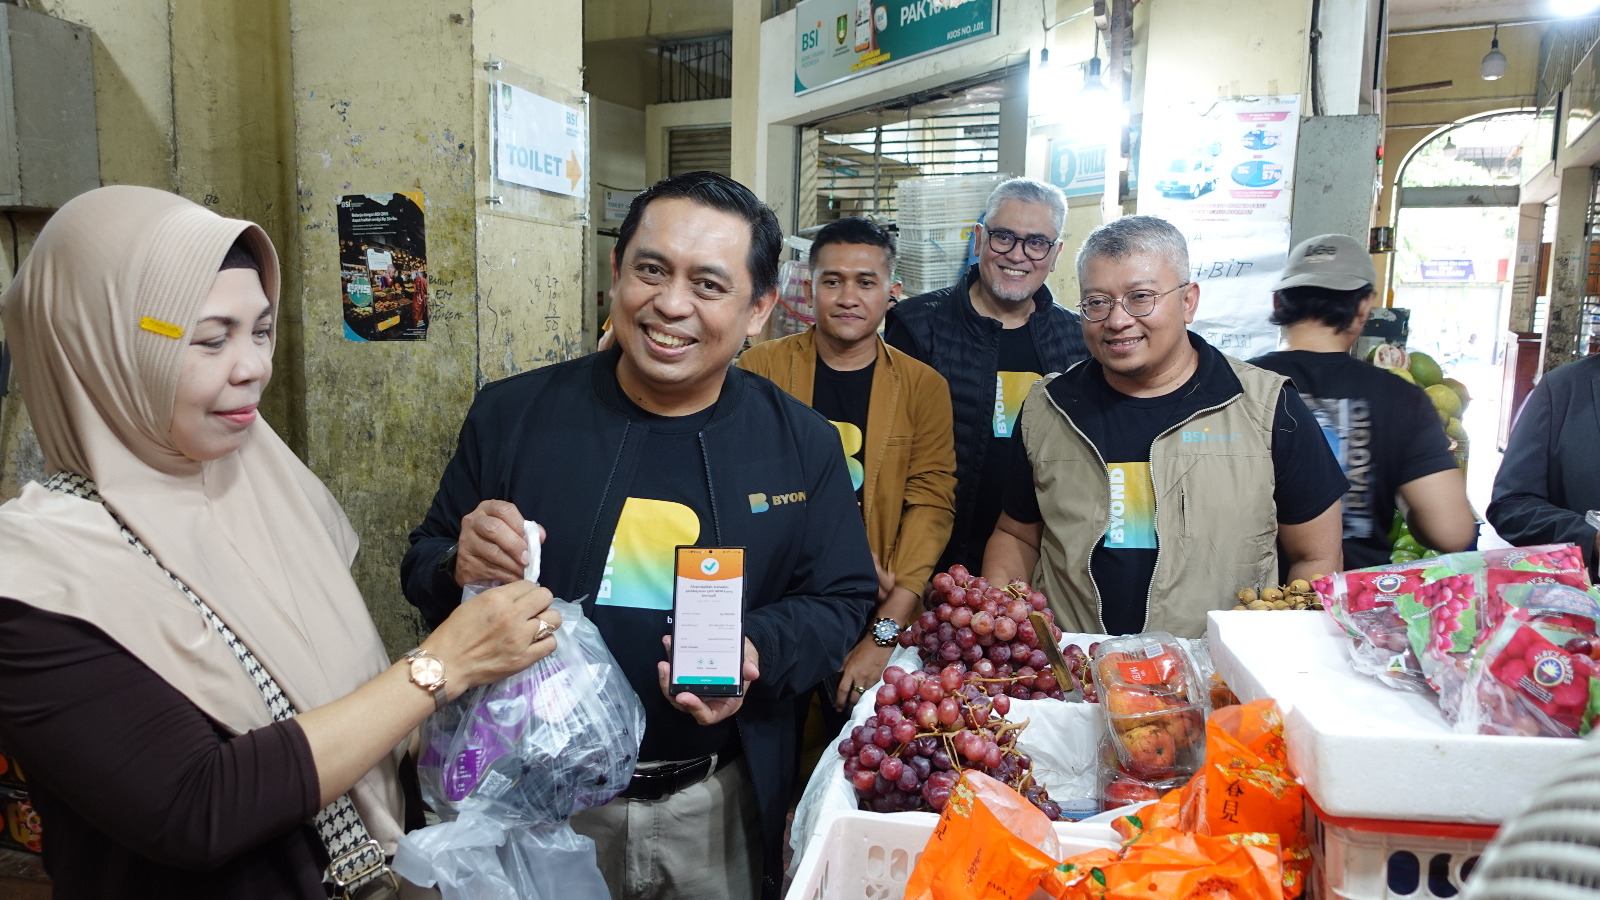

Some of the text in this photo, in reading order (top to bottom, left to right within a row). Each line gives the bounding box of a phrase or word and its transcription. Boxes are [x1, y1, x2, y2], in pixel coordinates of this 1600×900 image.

[900, 0, 927, 26] PAK
[802, 28, 818, 52] BSI
[946, 29, 960, 40] KIOS
[566, 111, 577, 127] BSI
[506, 143, 562, 176] TOILET
[1182, 431, 1206, 443] BSI
[772, 491, 807, 506] BYON
[1110, 467, 1125, 544] BYOND
[1560, 655, 1574, 686] GRAPES
